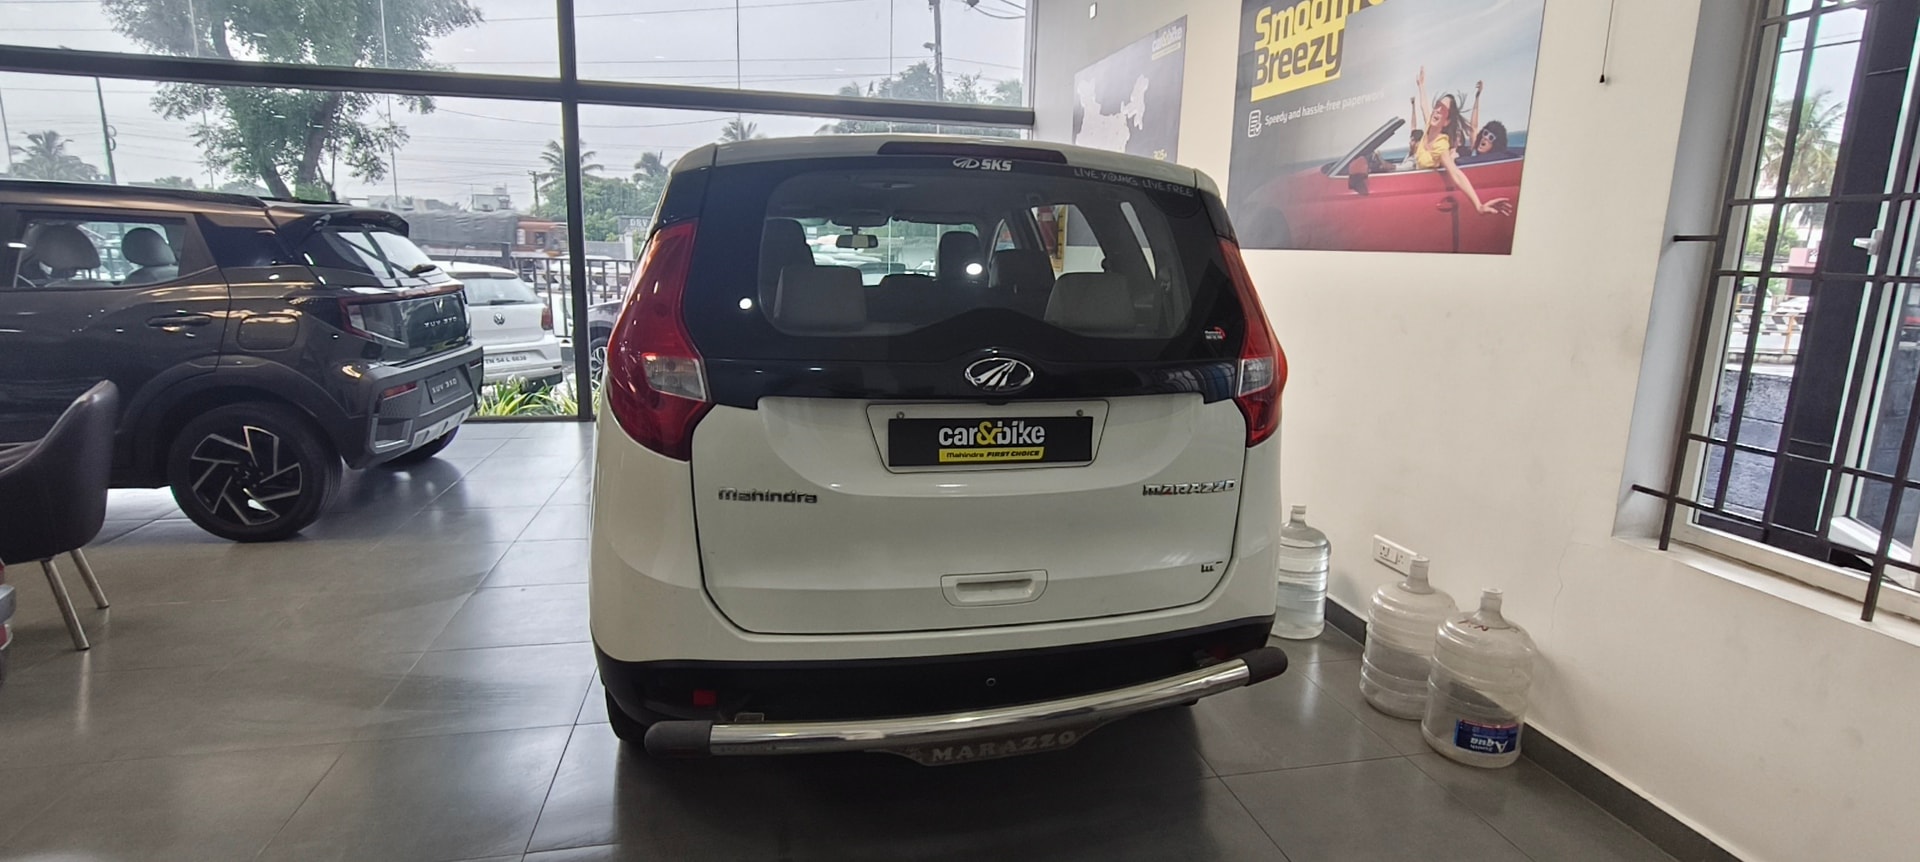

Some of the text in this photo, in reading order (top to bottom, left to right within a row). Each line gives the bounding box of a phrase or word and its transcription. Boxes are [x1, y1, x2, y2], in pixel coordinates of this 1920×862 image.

[1252, 28, 1345, 88] Breezy
[1264, 112, 1288, 126] Speedy
[1288, 108, 1301, 120] and
[1301, 99, 1341, 116] hassle-free
[980, 158, 1013, 172] SKS
[1074, 167, 1099, 179] LIVE
[1143, 179, 1165, 191] LIVE
[938, 420, 1046, 447] car&bike
[986, 450, 1010, 458] FIRST
[718, 487, 818, 504] Mahindra
[931, 730, 1077, 763] MARAZZO
[1469, 737, 1508, 753] Aqua
